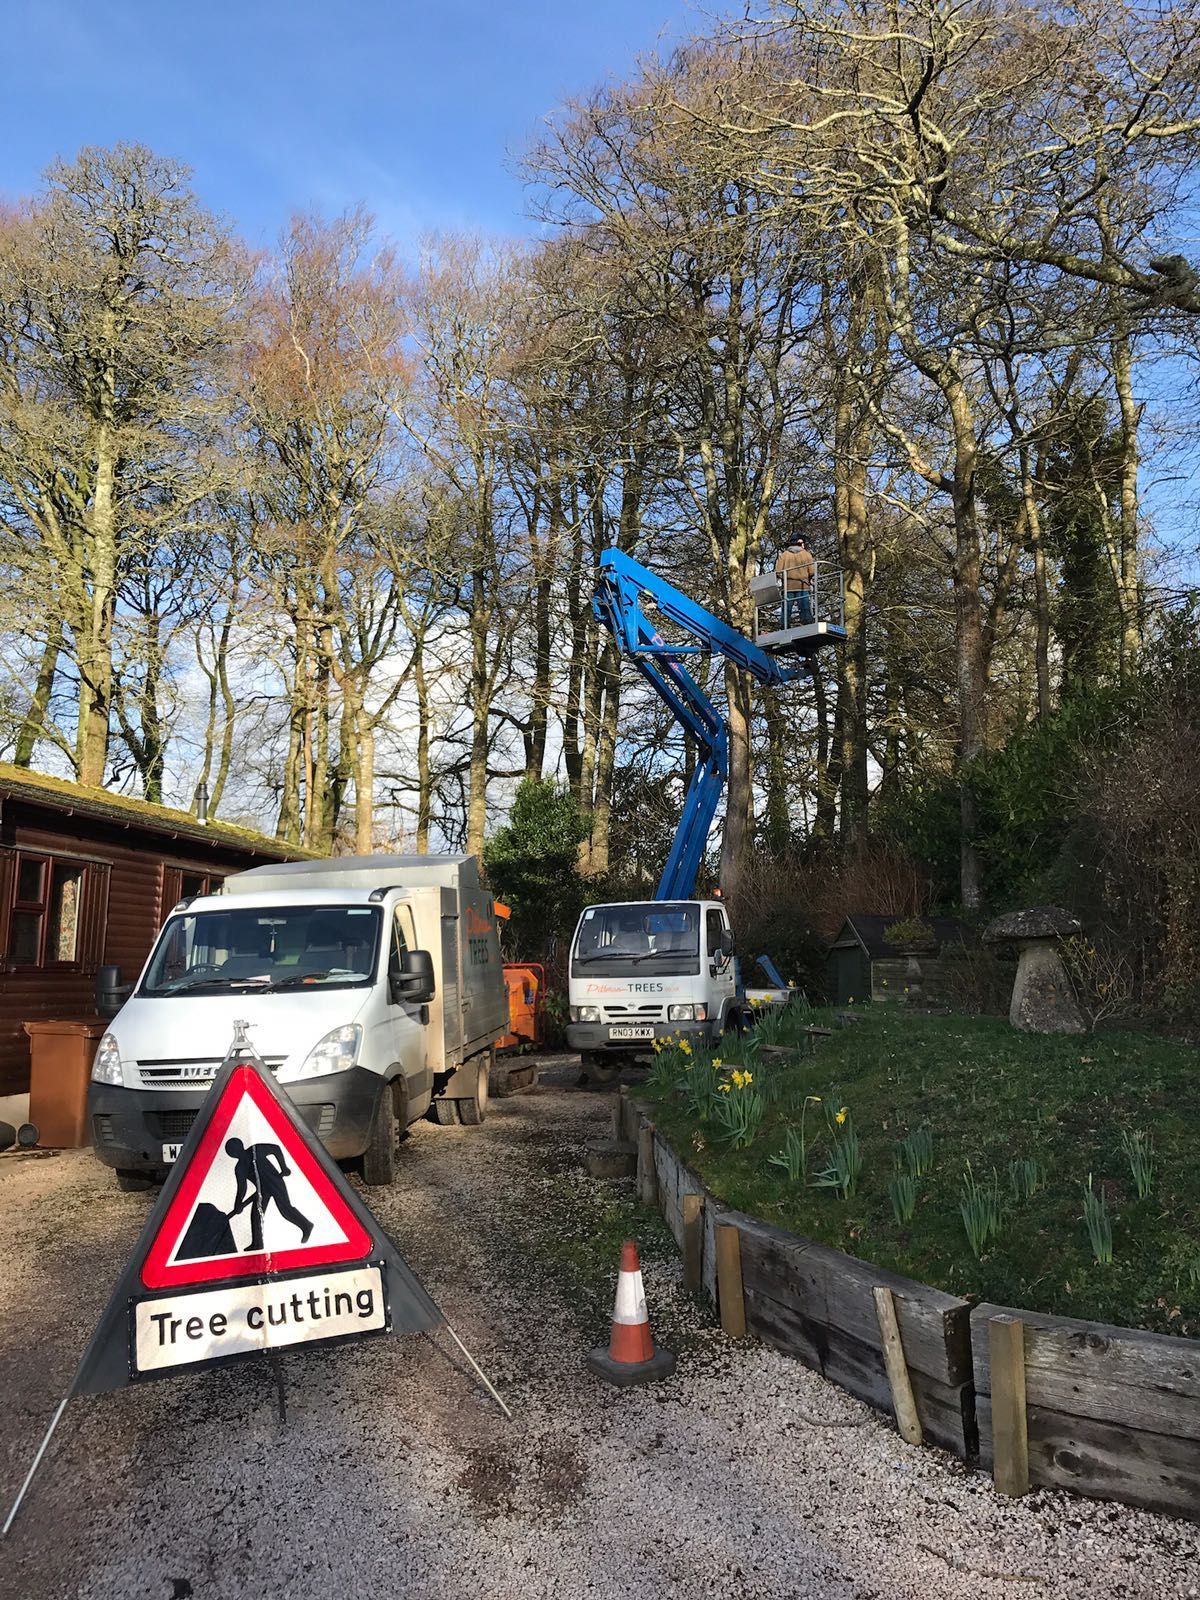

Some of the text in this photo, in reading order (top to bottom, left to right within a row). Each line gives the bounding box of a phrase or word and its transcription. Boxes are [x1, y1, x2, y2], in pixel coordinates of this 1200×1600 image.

[469, 938, 489, 966] TREES
[627, 982, 664, 993] TREES
[612, 1028, 652, 1037] RN03 KWX
[180, 1067, 220, 1078] IVEC
[150, 1287, 374, 1346] Tree cutting
